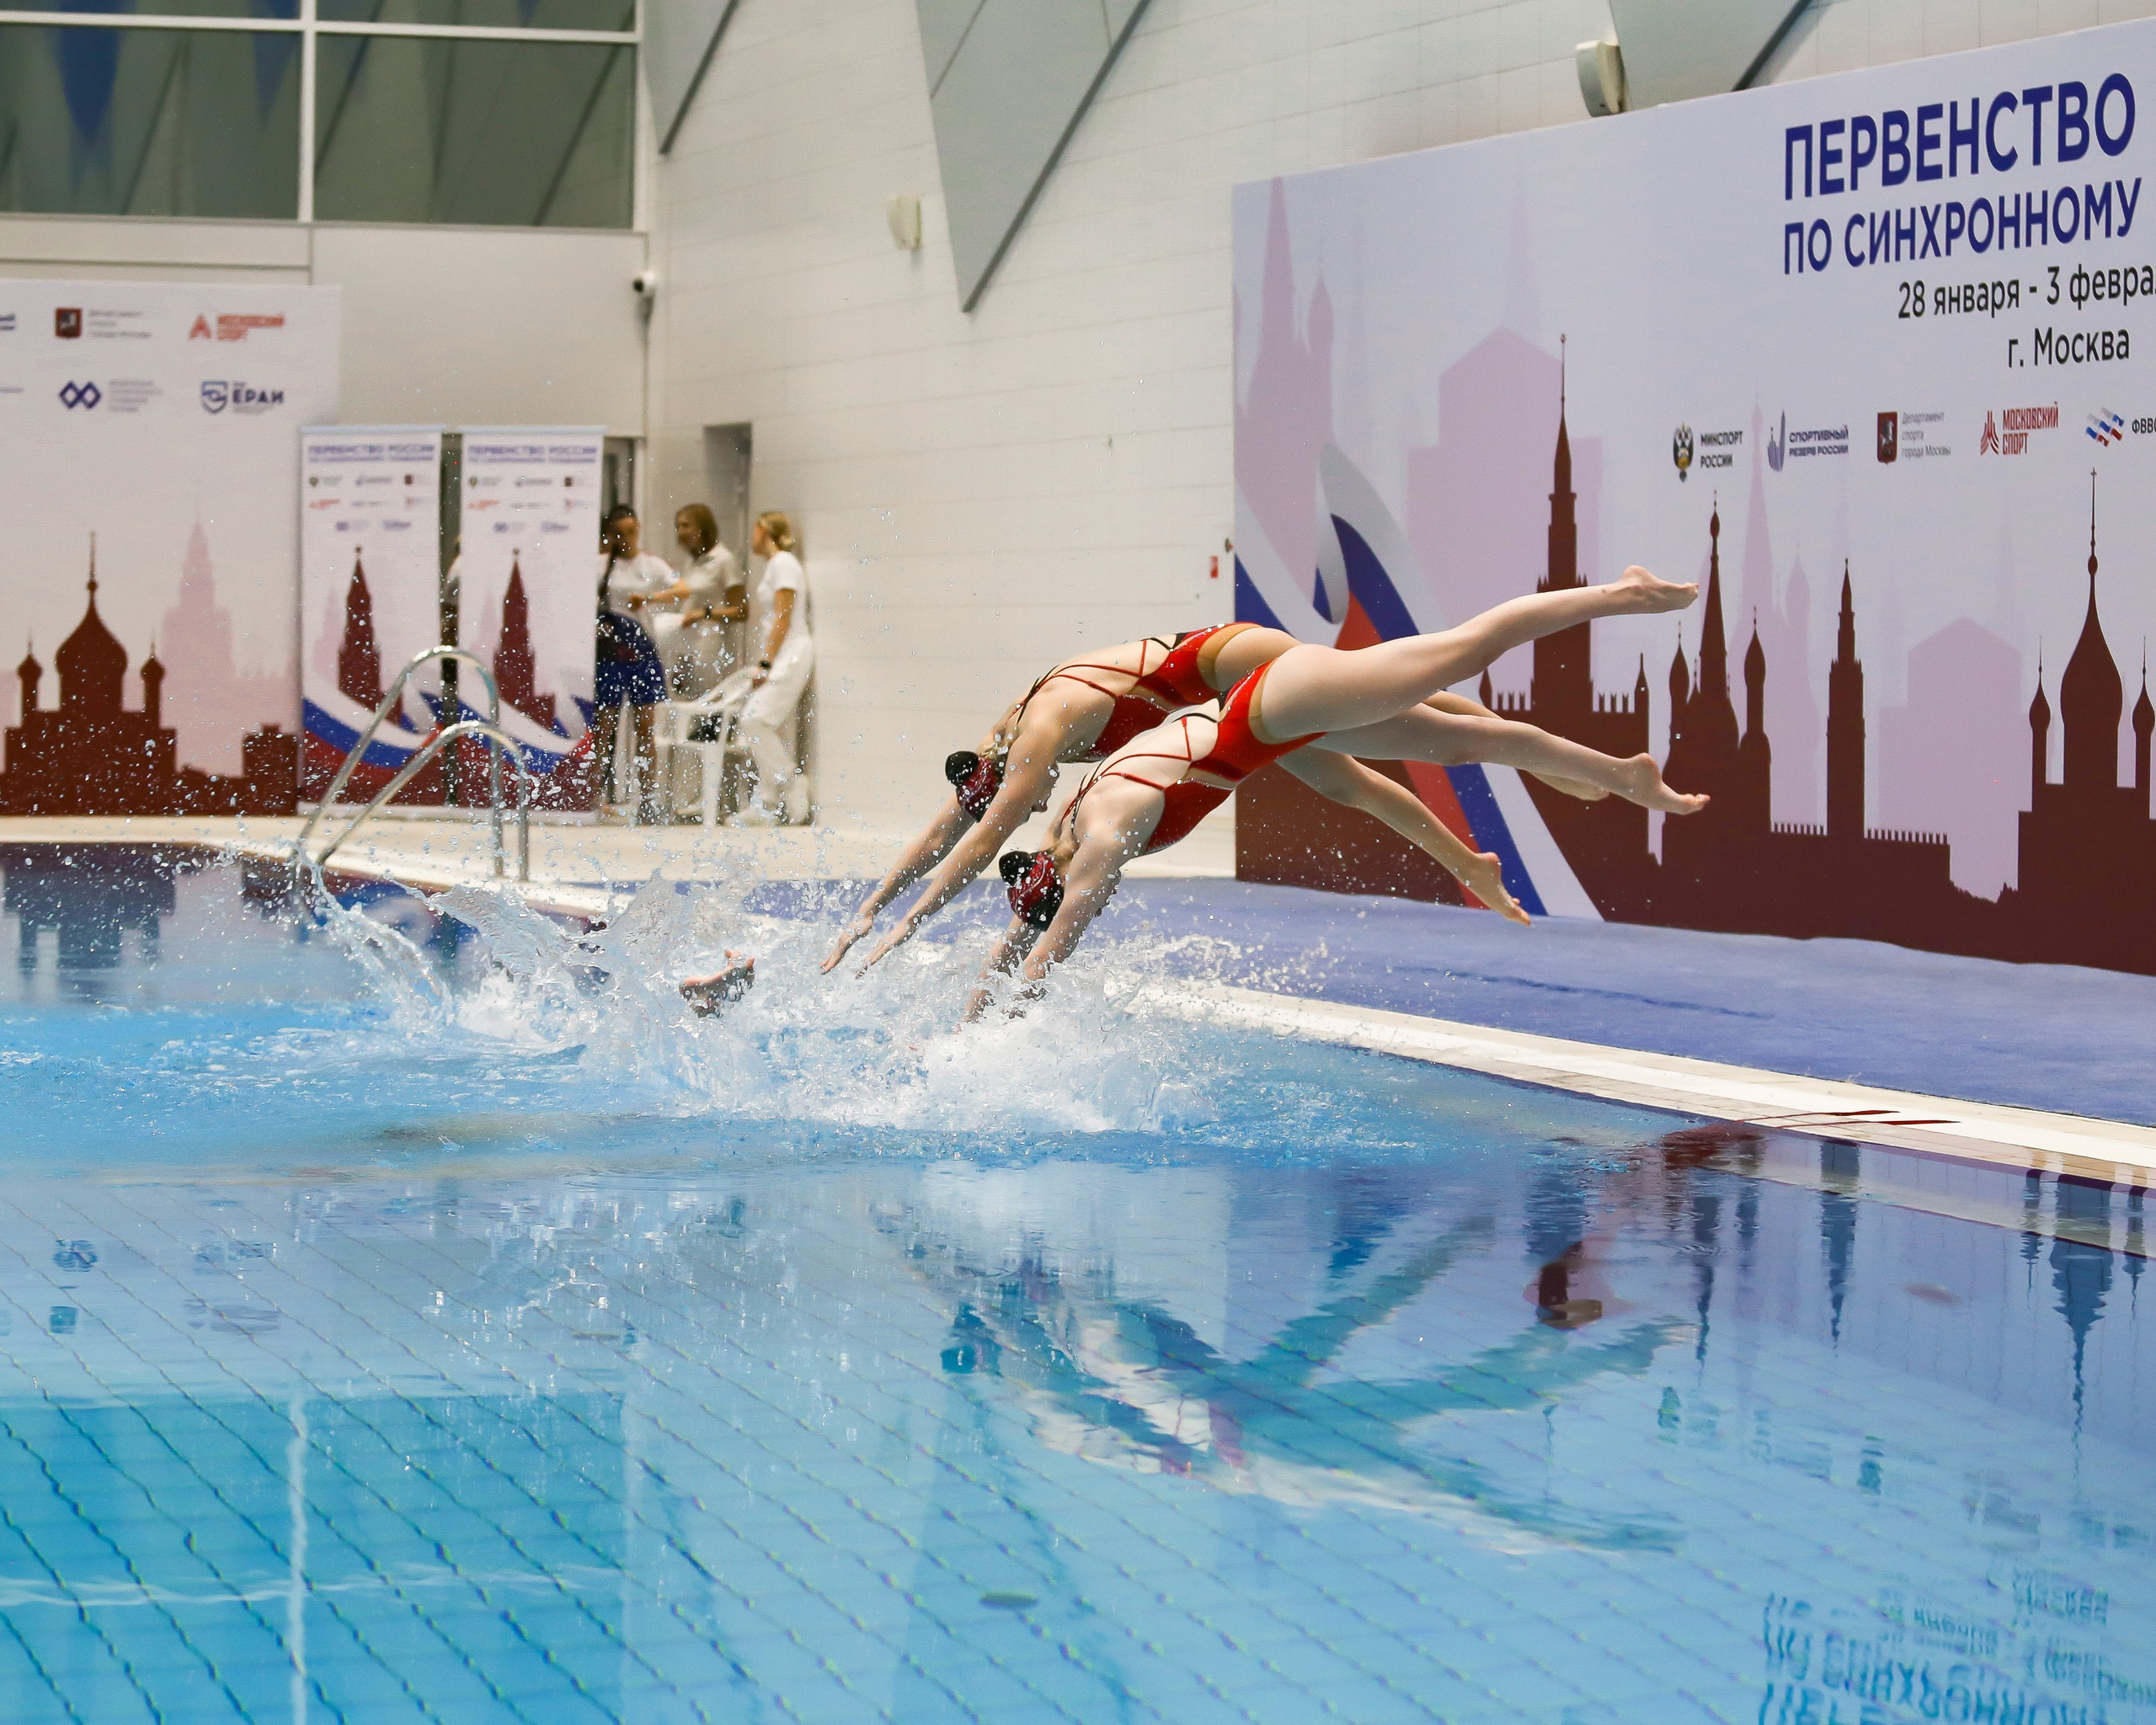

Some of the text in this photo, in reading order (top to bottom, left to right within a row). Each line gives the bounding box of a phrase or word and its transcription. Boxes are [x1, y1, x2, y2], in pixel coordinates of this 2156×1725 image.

[1785, 72, 2136, 200] ПЕРВЕНСТВО
[1785, 177, 2142, 275] ПО СИНХРОННОМУ
[1898, 280, 1925, 318] 28
[1934, 280, 2020, 318] января
[2047, 265, 2060, 305] 3
[2069, 264, 2156, 310] февра
[2009, 327, 2130, 368] г. Москва
[2003, 401, 2059, 431] МОСКОВСКИЙ
[2132, 417, 2156, 434] ФВВ
[1700, 430, 1743, 446] МИНСПОРТ
[1789, 425, 1849, 443] СПОРТИВНЫЙ
[2003, 432, 2029, 455] СПОРТ
[1700, 453, 1732, 468] РОССИИ
[1789, 444, 1849, 457] РЕЗЕРВ РОССИИ
